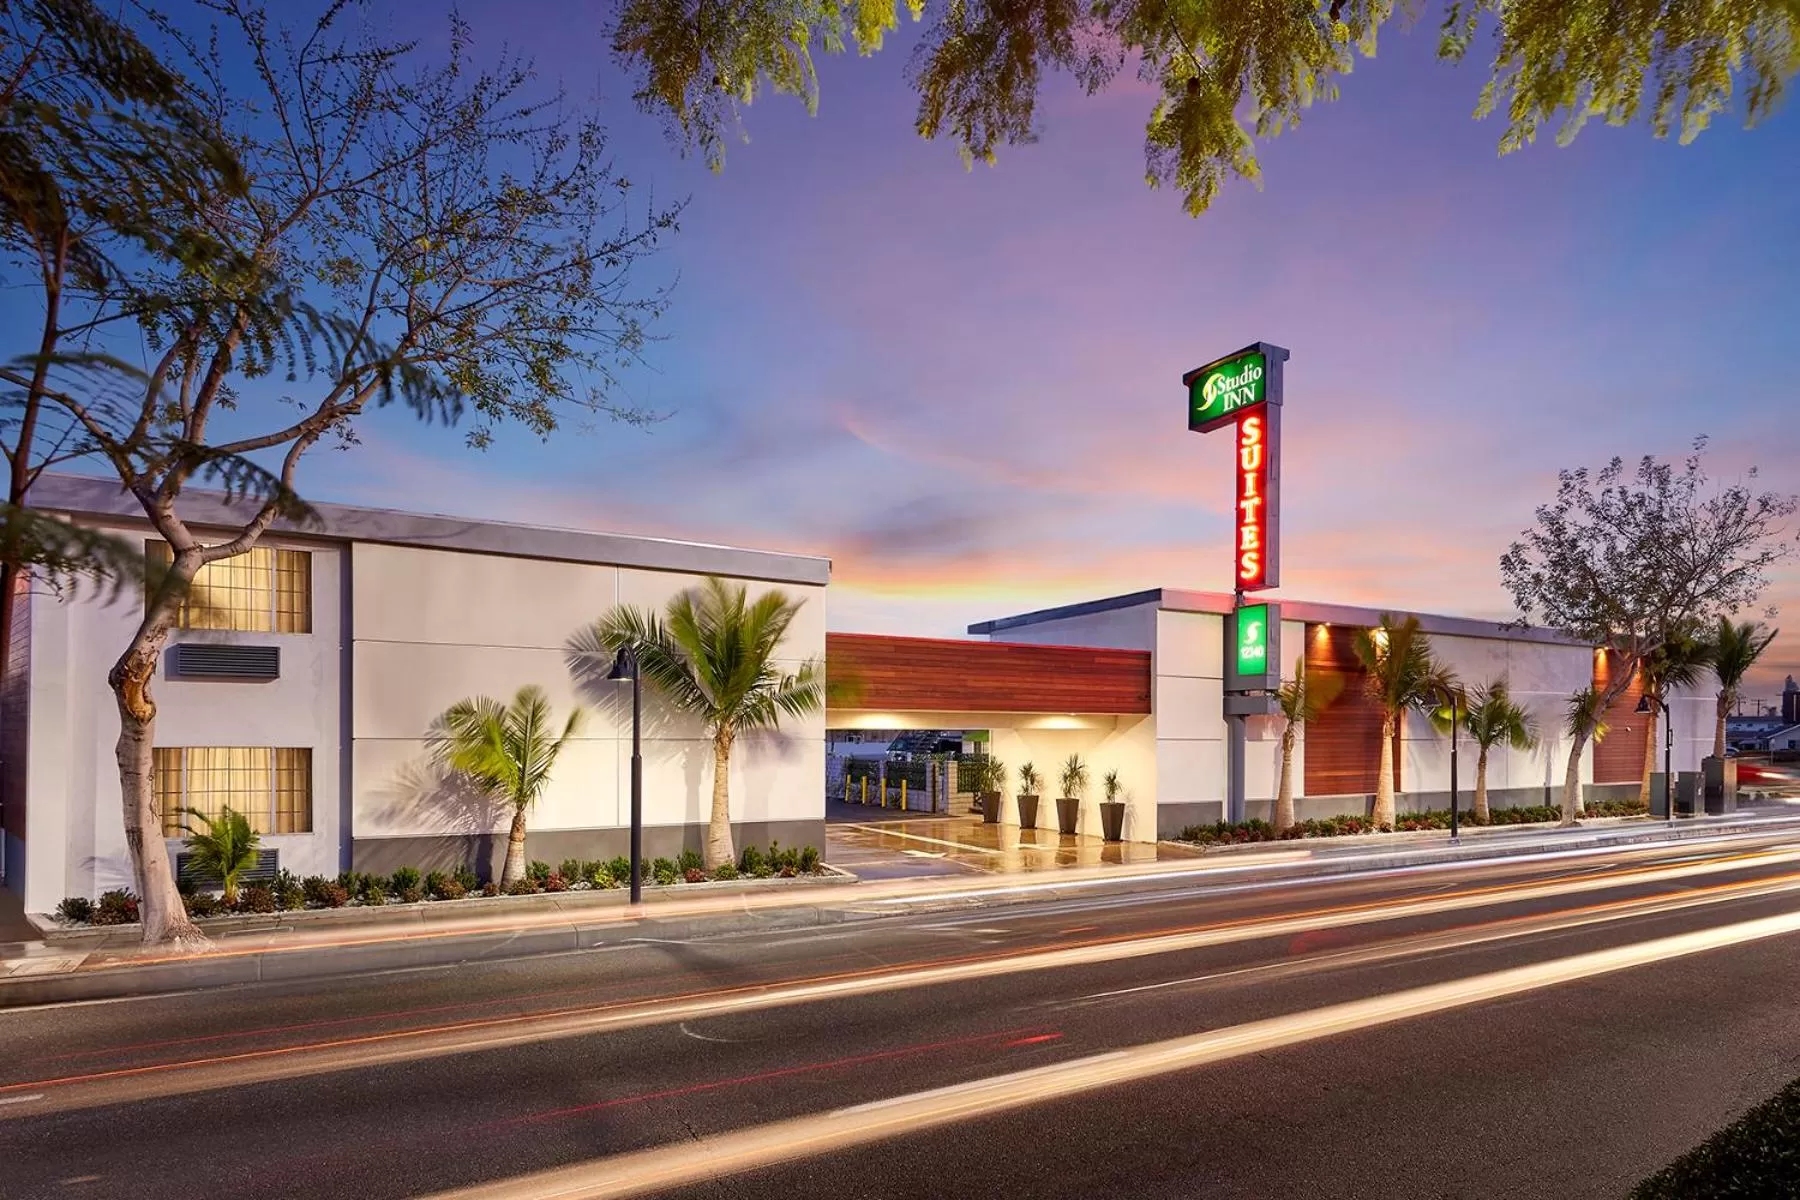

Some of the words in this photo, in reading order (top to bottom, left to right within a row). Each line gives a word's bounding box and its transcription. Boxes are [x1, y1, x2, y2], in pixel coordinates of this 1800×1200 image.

[1215, 363, 1262, 395] Studio
[1223, 383, 1256, 412] INN
[1239, 416, 1263, 579] SUITES
